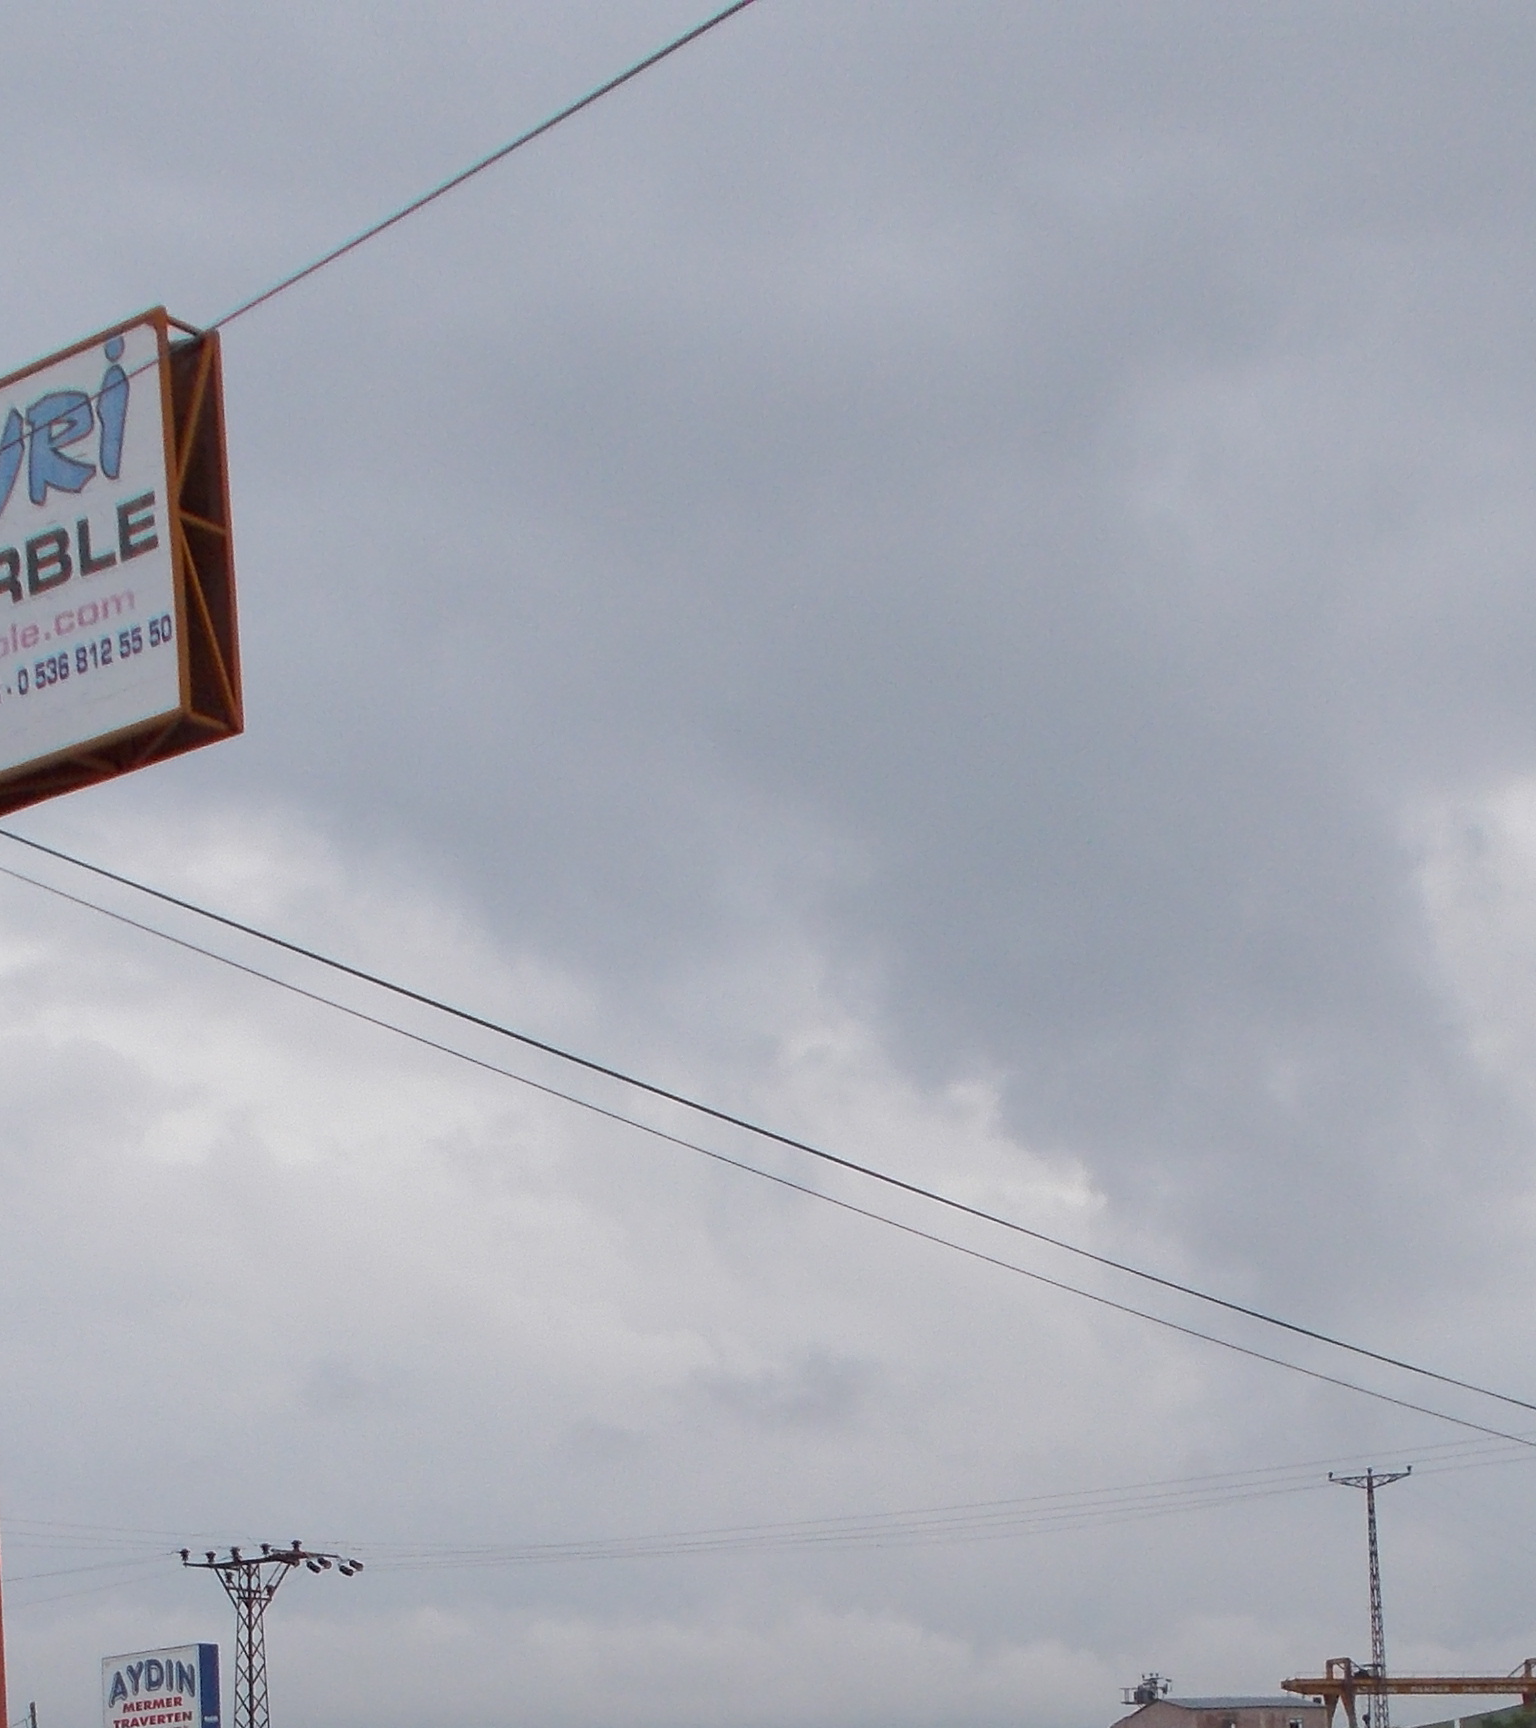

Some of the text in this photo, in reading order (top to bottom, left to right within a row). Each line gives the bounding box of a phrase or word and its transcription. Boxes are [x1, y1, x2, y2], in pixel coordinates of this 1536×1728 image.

[18, 667, 29, 696] 0
[35, 653, 70, 690] 536
[76, 637, 113, 674] 812
[119, 626, 143, 660] 55
[148, 614, 173, 648] 50
[109, 1659, 196, 1708] AYDIN
[122, 1696, 183, 1714] MERMER
